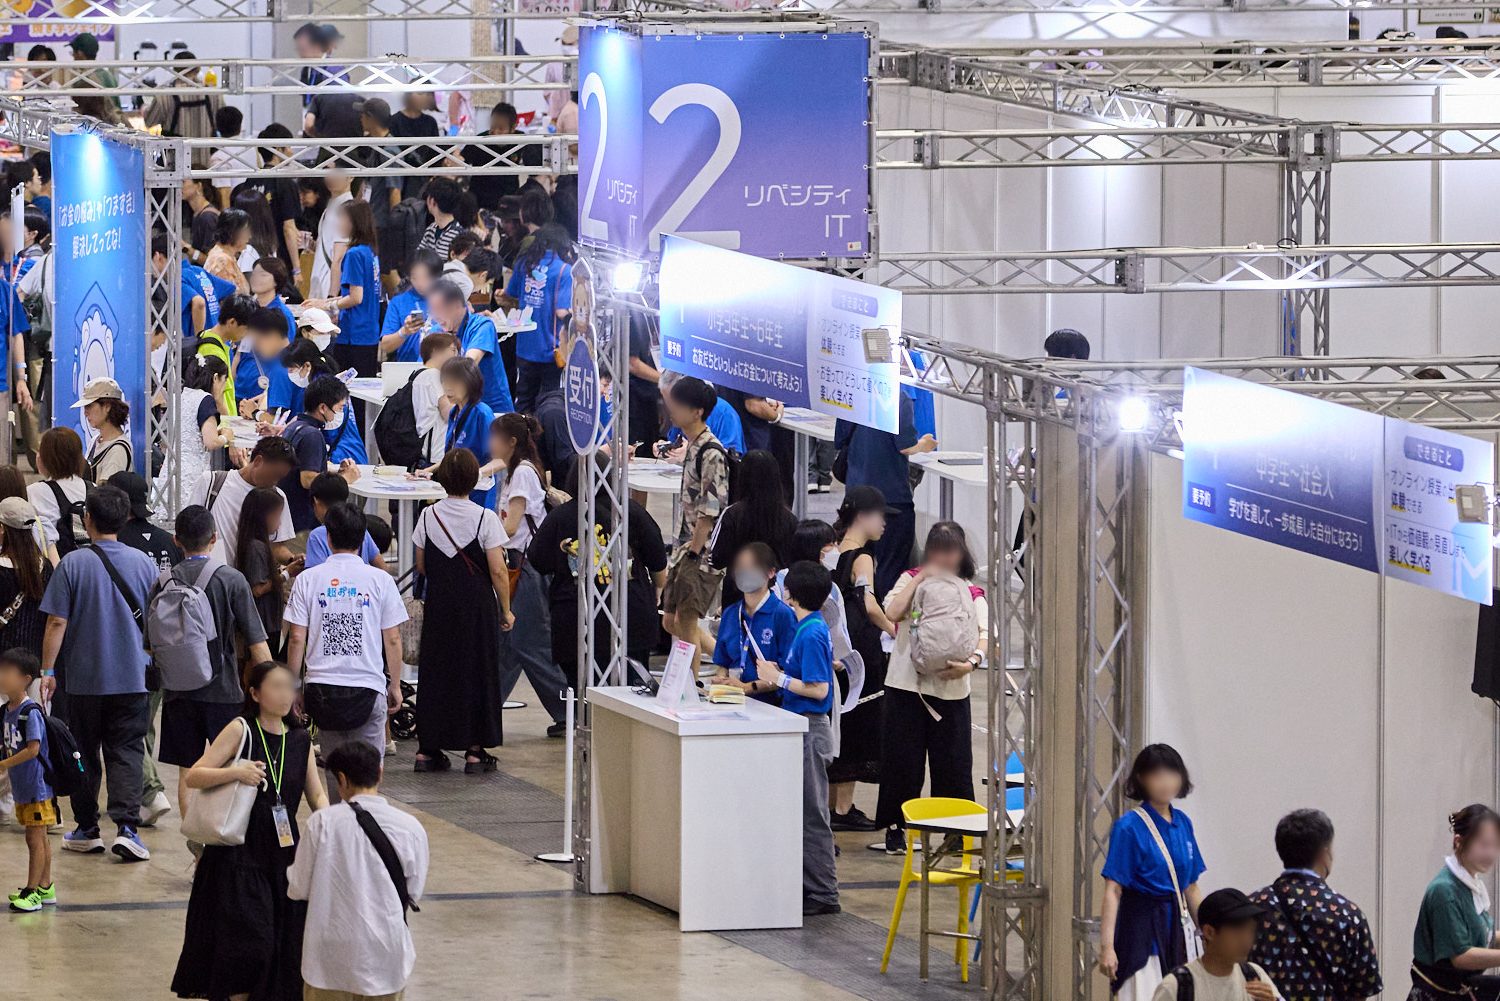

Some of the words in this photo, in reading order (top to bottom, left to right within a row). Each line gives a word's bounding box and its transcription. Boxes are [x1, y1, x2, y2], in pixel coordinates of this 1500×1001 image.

[580, 72, 609, 242] 2
[648, 82, 742, 252] 2
[607, 178, 638, 206] リベシティ
[744, 184, 851, 207] リベシティ
[629, 214, 638, 238] IT
[825, 213, 851, 238] IT
[569, 365, 594, 410] 受付
[570, 407, 593, 425] RECEPTION
[1416, 443, 1453, 466] できること
[1191, 487, 1212, 508] 要予約
[1228, 496, 1363, 553] 学びを通して、一歩成長した自分になろう!
[1389, 544, 1432, 573] 楽しく学べる
